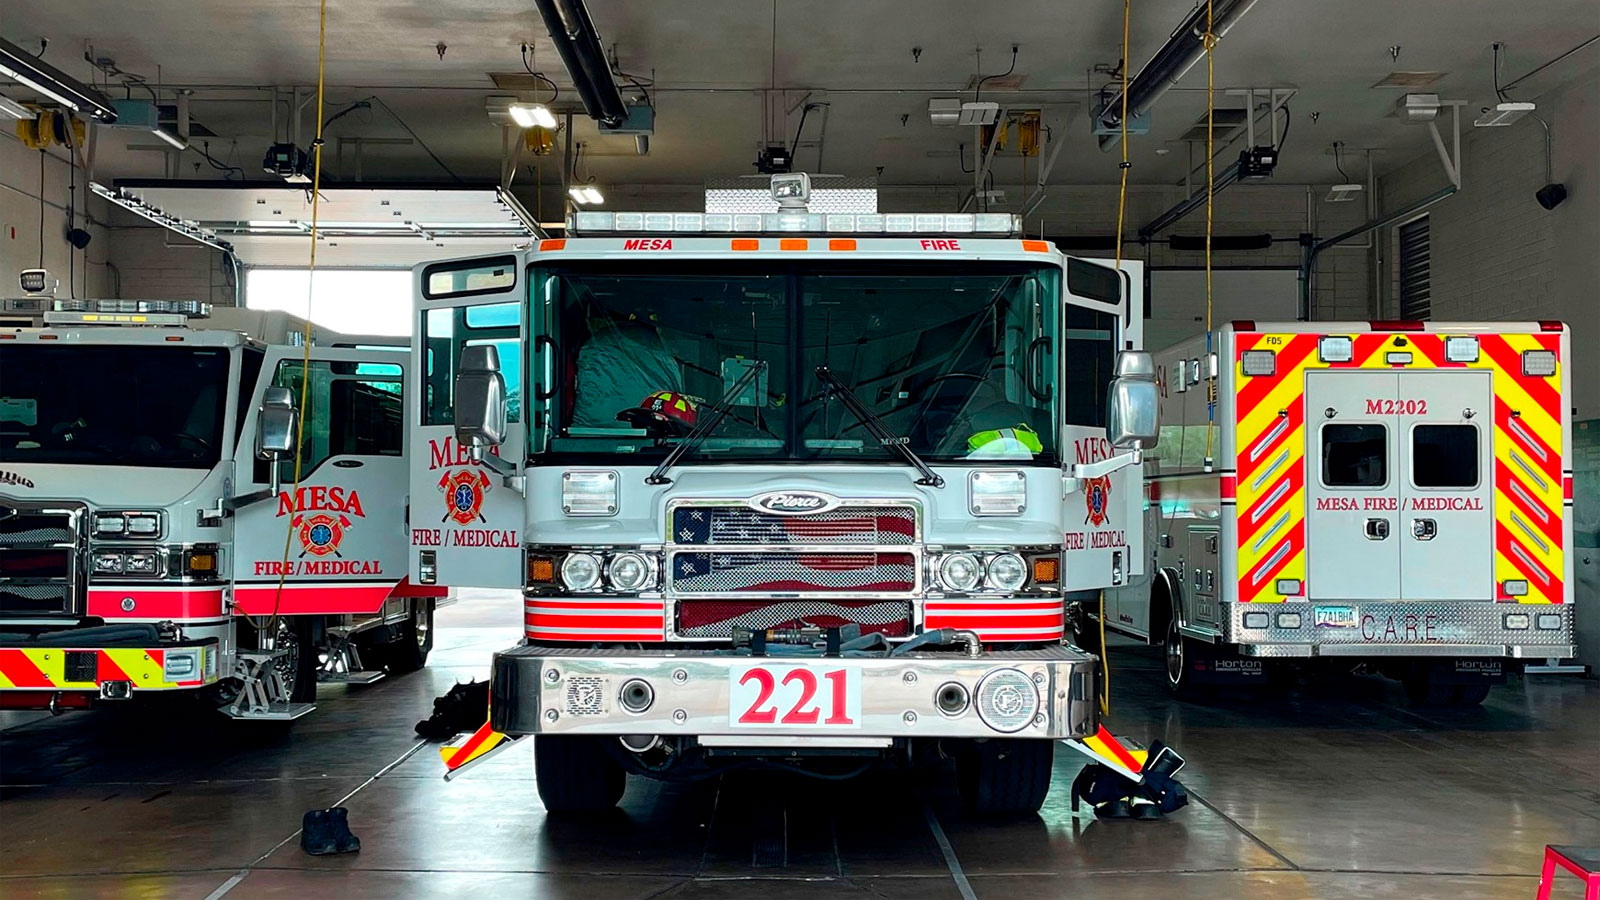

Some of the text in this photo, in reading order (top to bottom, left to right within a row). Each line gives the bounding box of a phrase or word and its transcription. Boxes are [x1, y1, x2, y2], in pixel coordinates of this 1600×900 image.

[624, 239, 672, 251] MESA
[920, 239, 961, 251] FIRE
[1365, 399, 1427, 415] M2202
[428, 435, 500, 470] ME
[276, 486, 366, 518] MESA
[766, 494, 821, 509] Pierce
[1316, 497, 1484, 512] MESA FIRE / MEDICAL
[412, 529, 441, 546] FIRE
[453, 529, 520, 548] MEDICAL
[1065, 532, 1084, 550] FIRE
[1091, 530, 1126, 549] MEDICAL
[1361, 614, 1443, 641] C.A.R.E.
[1215, 659, 1262, 668] Horton
[738, 667, 853, 725] 221
